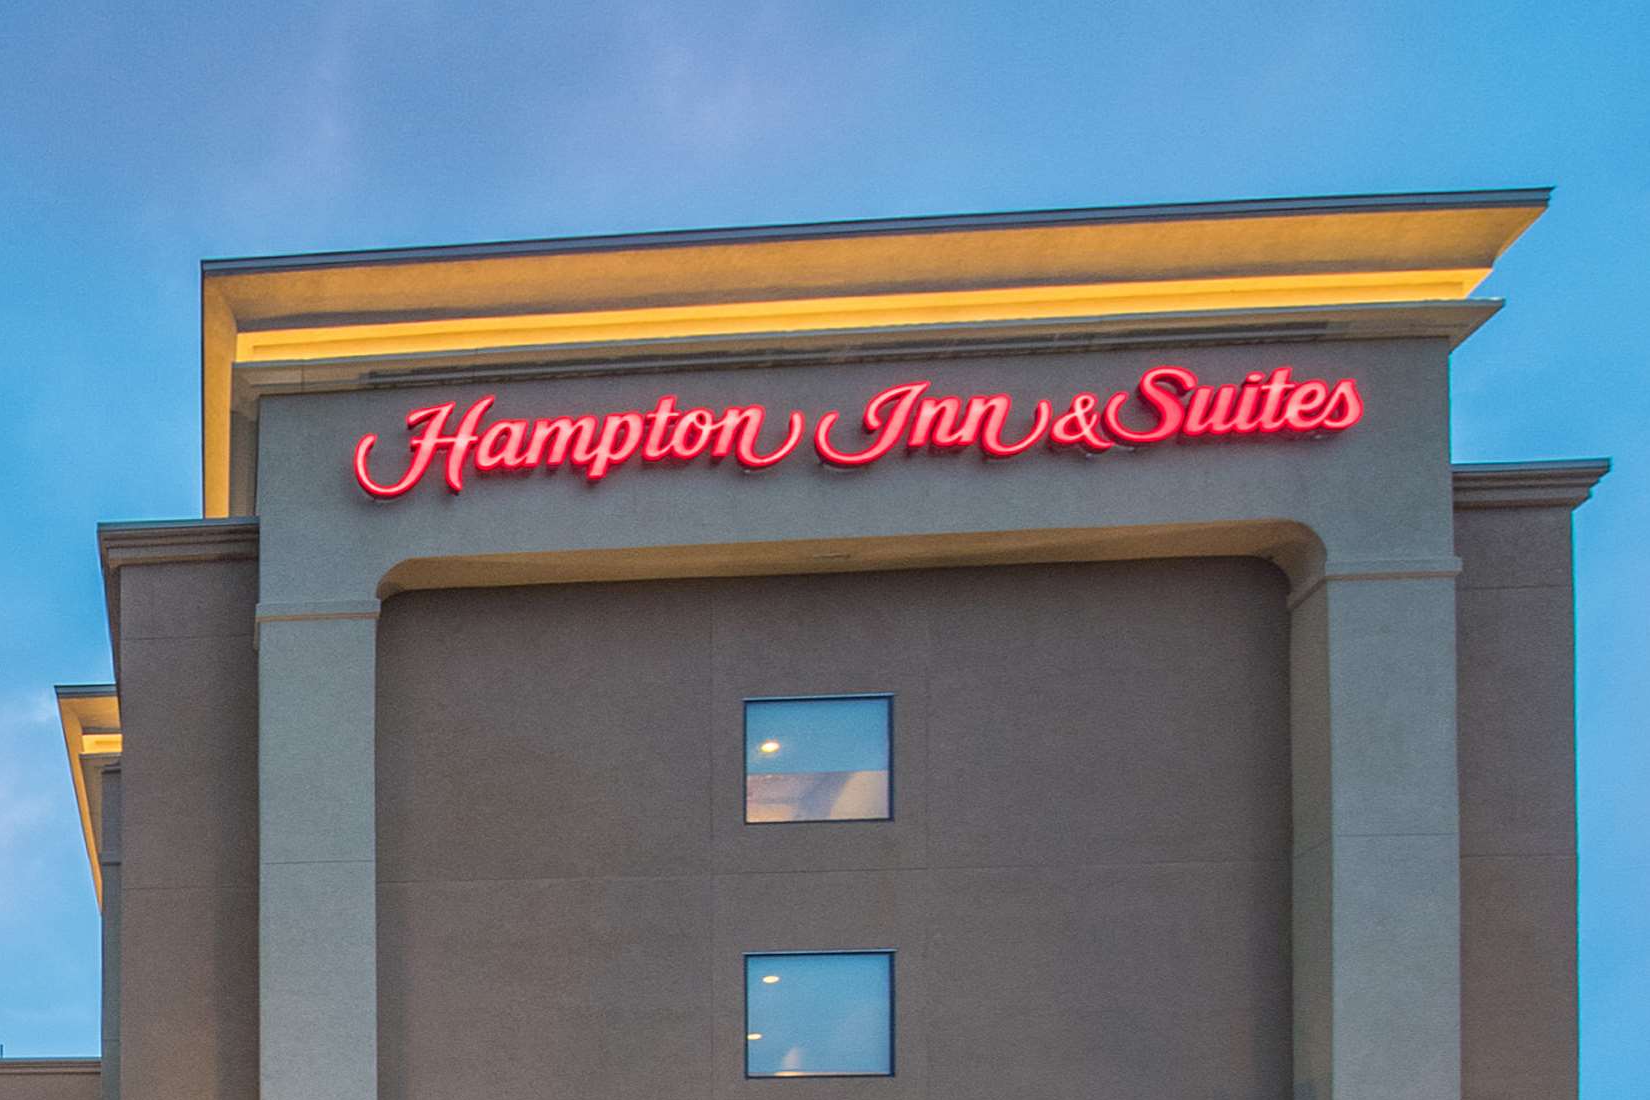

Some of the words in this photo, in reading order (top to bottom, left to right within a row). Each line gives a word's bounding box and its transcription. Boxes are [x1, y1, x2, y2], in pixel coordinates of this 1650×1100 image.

[353, 394, 806, 497] Hampton
[813, 380, 1050, 466] Inn
[1050, 392, 1114, 451] &
[1102, 365, 1364, 443] Suites
